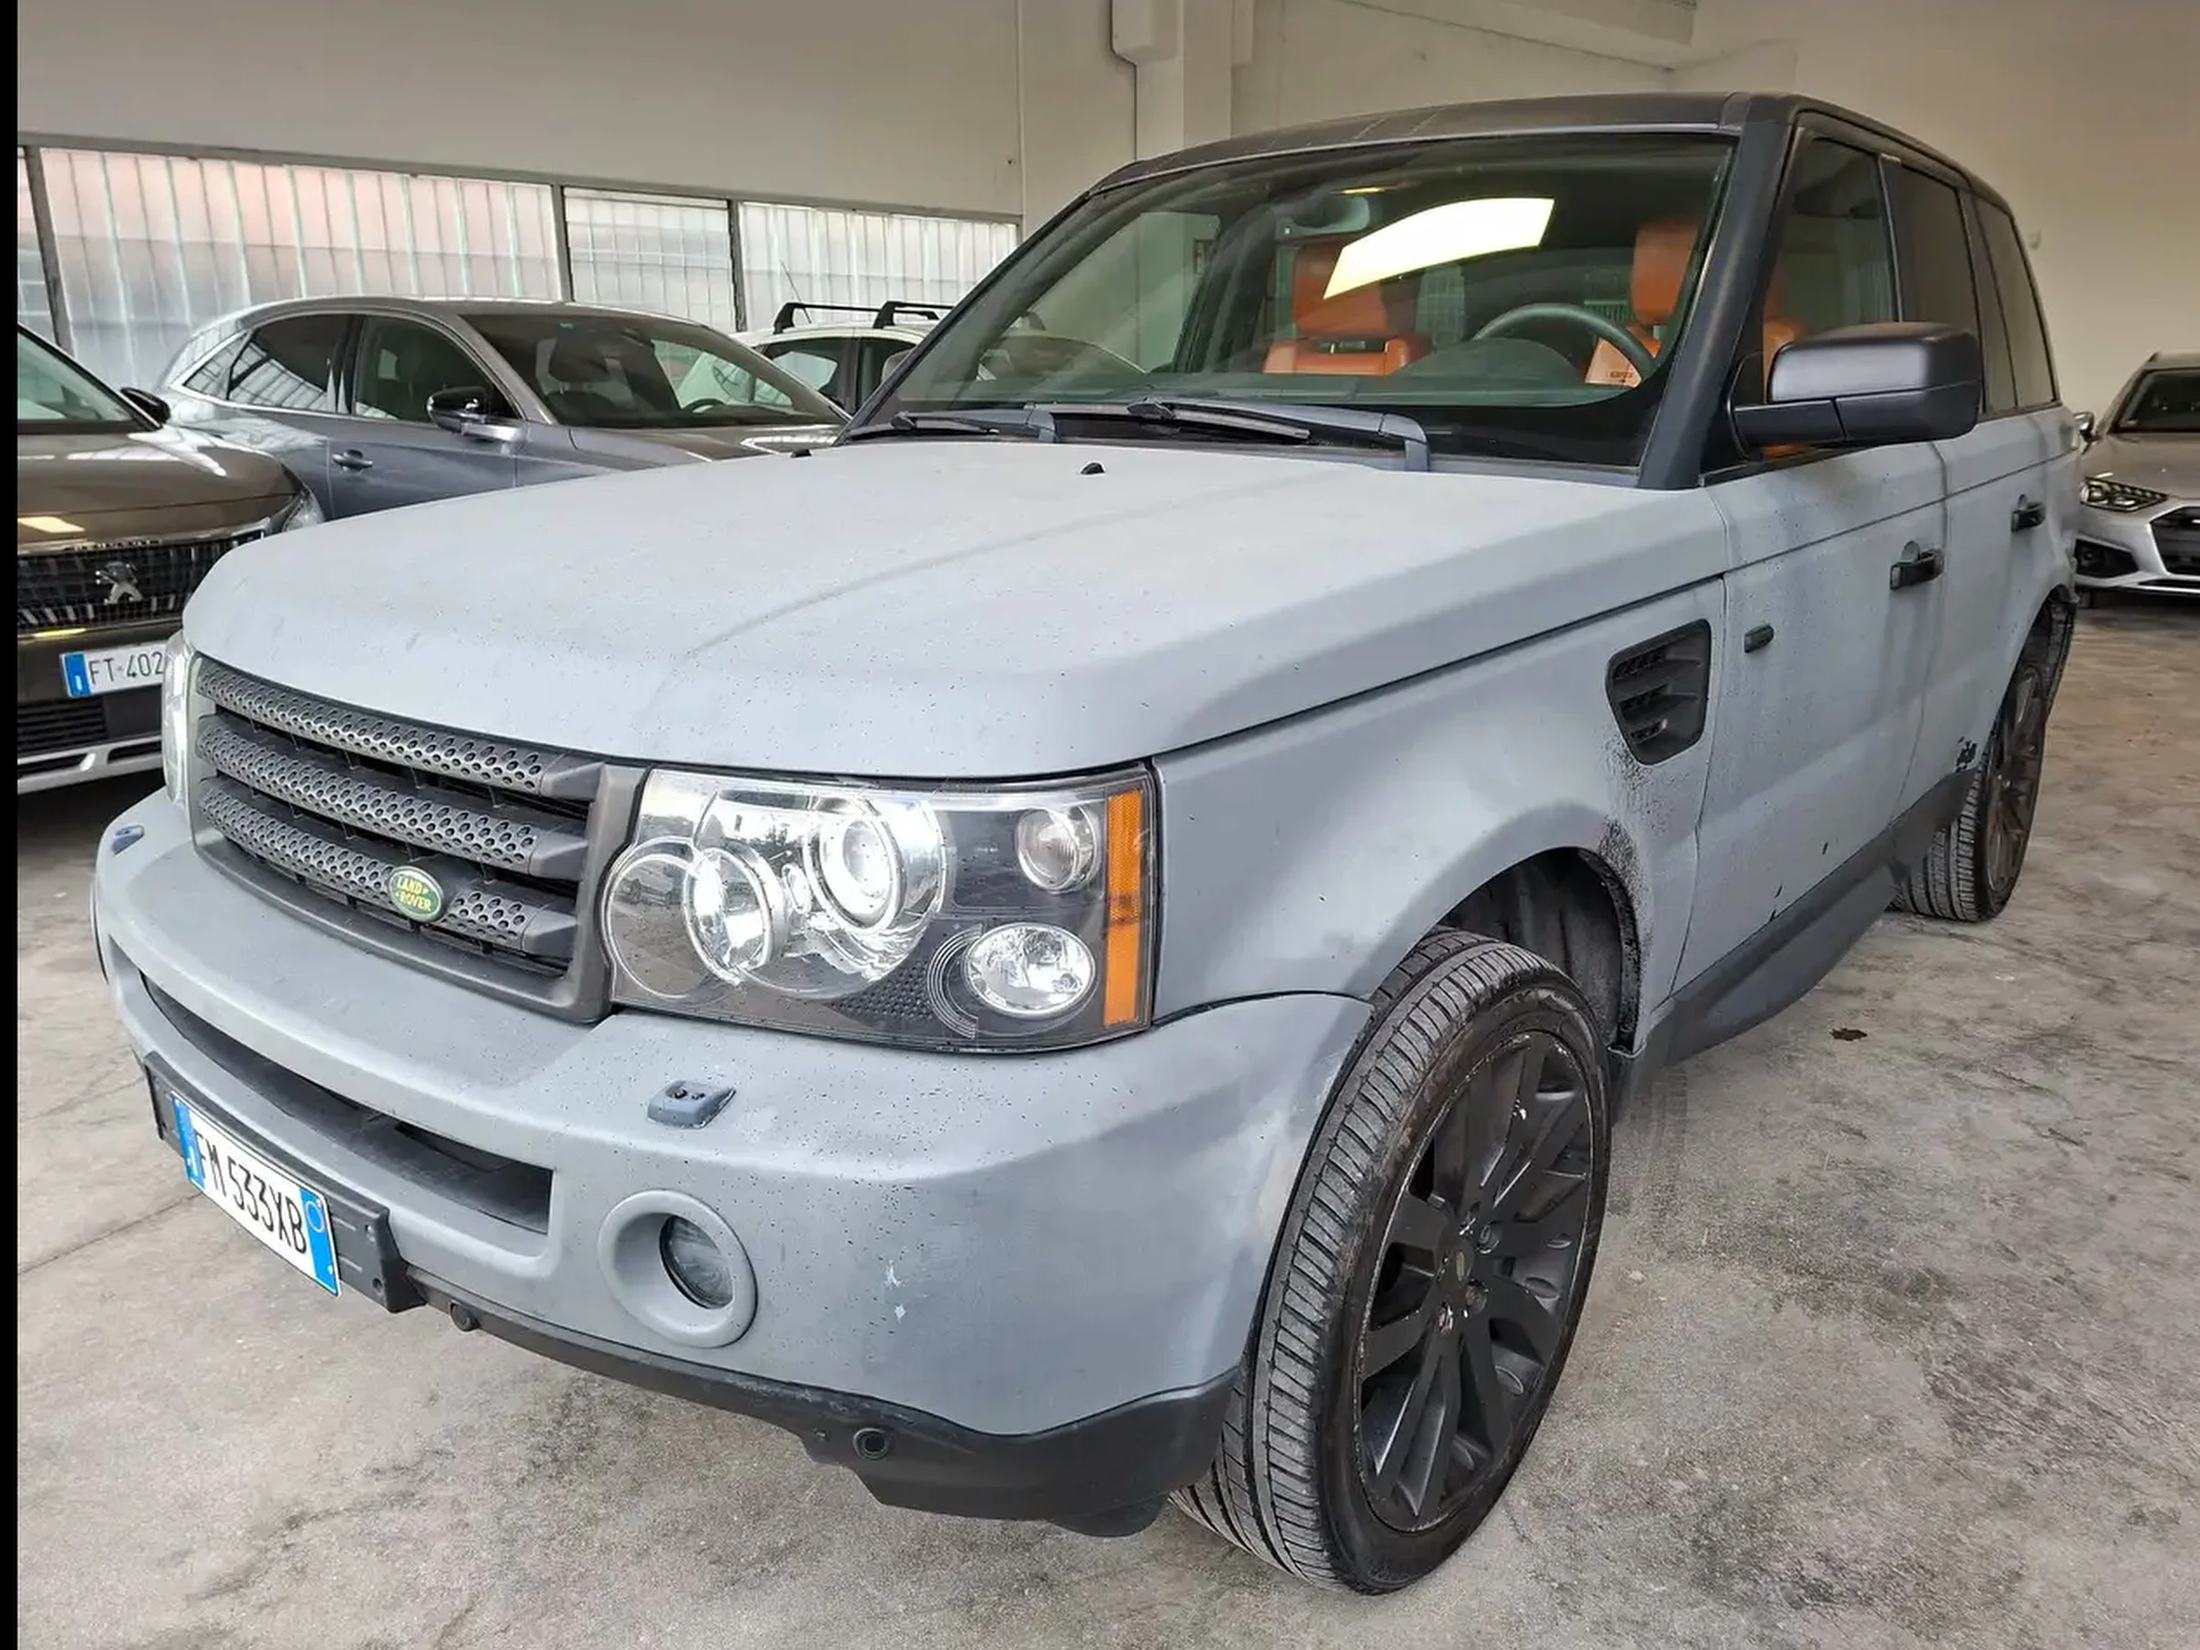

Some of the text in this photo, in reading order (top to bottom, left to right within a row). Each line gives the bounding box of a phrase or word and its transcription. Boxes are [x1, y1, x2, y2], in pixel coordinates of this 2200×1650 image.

[88, 651, 163, 685] FT 402
[396, 876, 424, 896] LAND
[398, 890, 433, 912] ROVER
